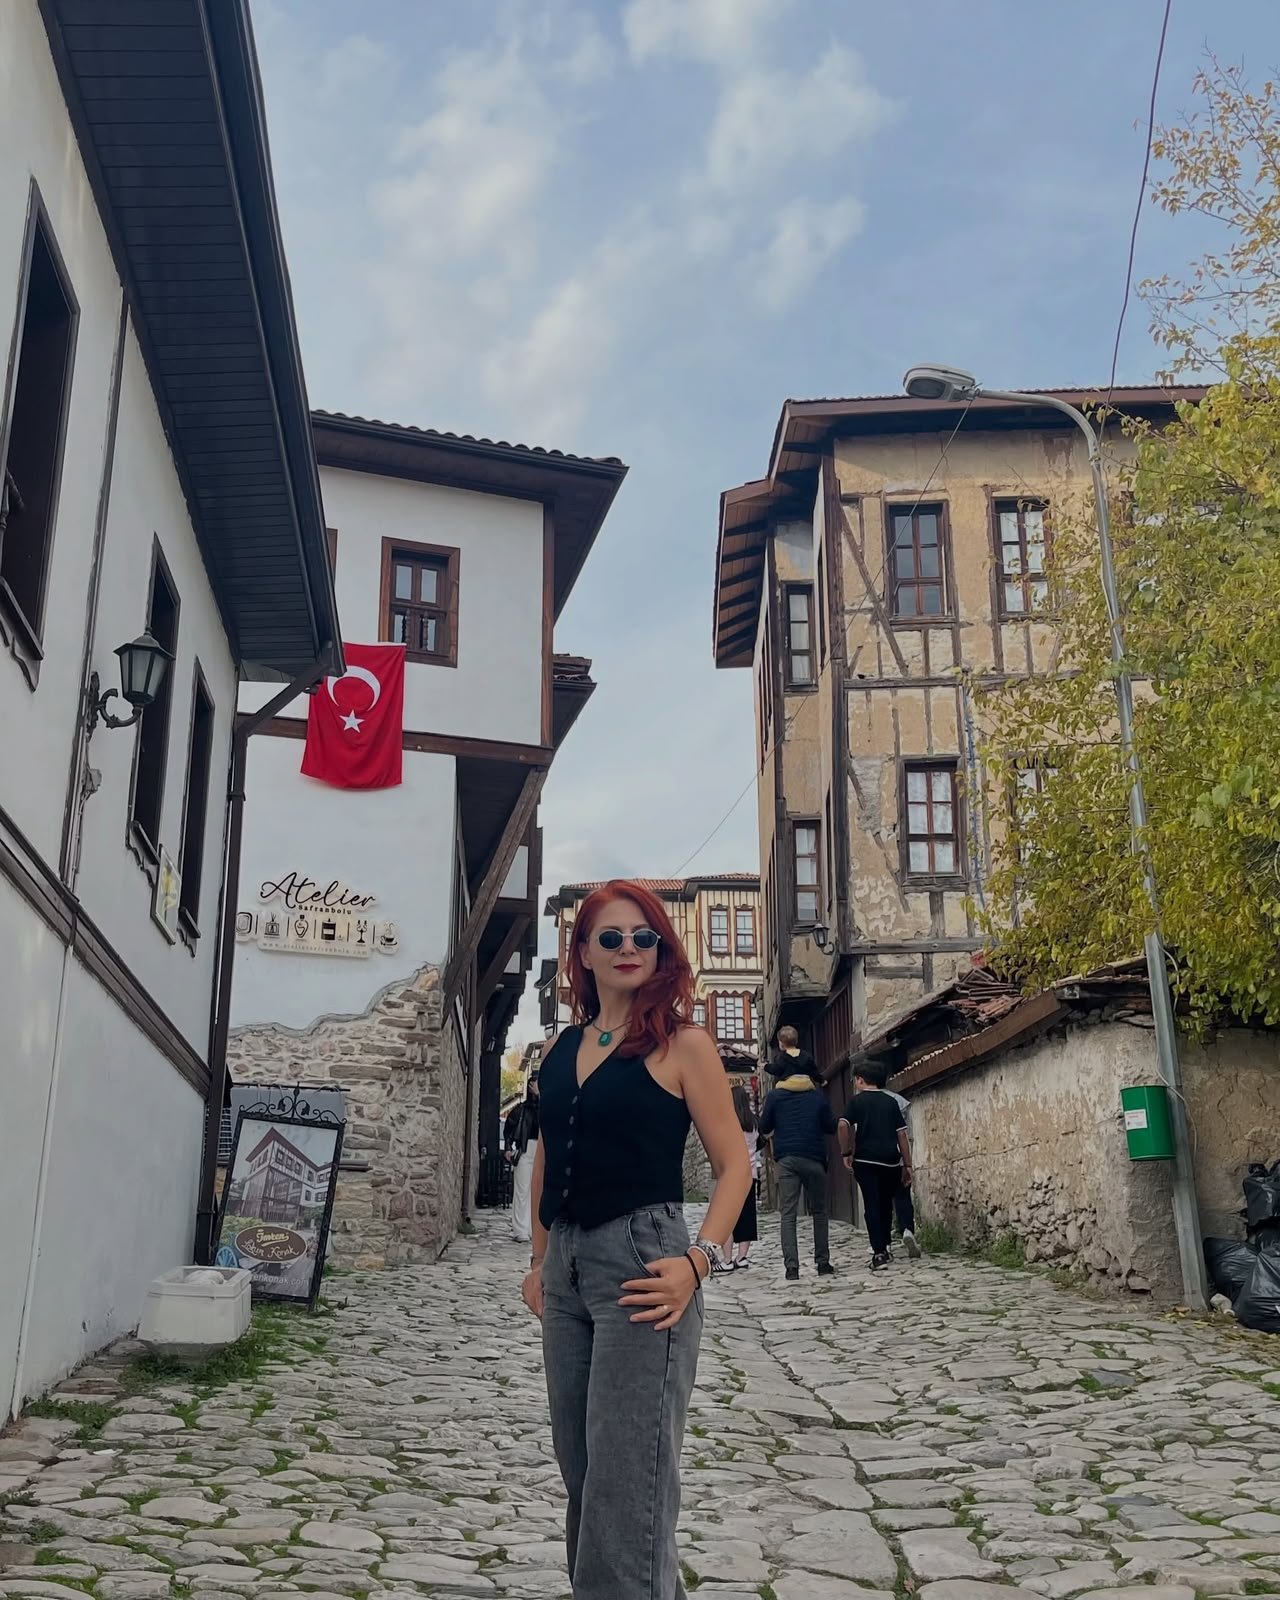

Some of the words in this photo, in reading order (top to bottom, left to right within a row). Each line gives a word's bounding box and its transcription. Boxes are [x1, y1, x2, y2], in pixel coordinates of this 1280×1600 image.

[260, 872, 375, 909] Atelier
[298, 904, 352, 915] Safranbolu
[268, 1245, 300, 1259] Konak
